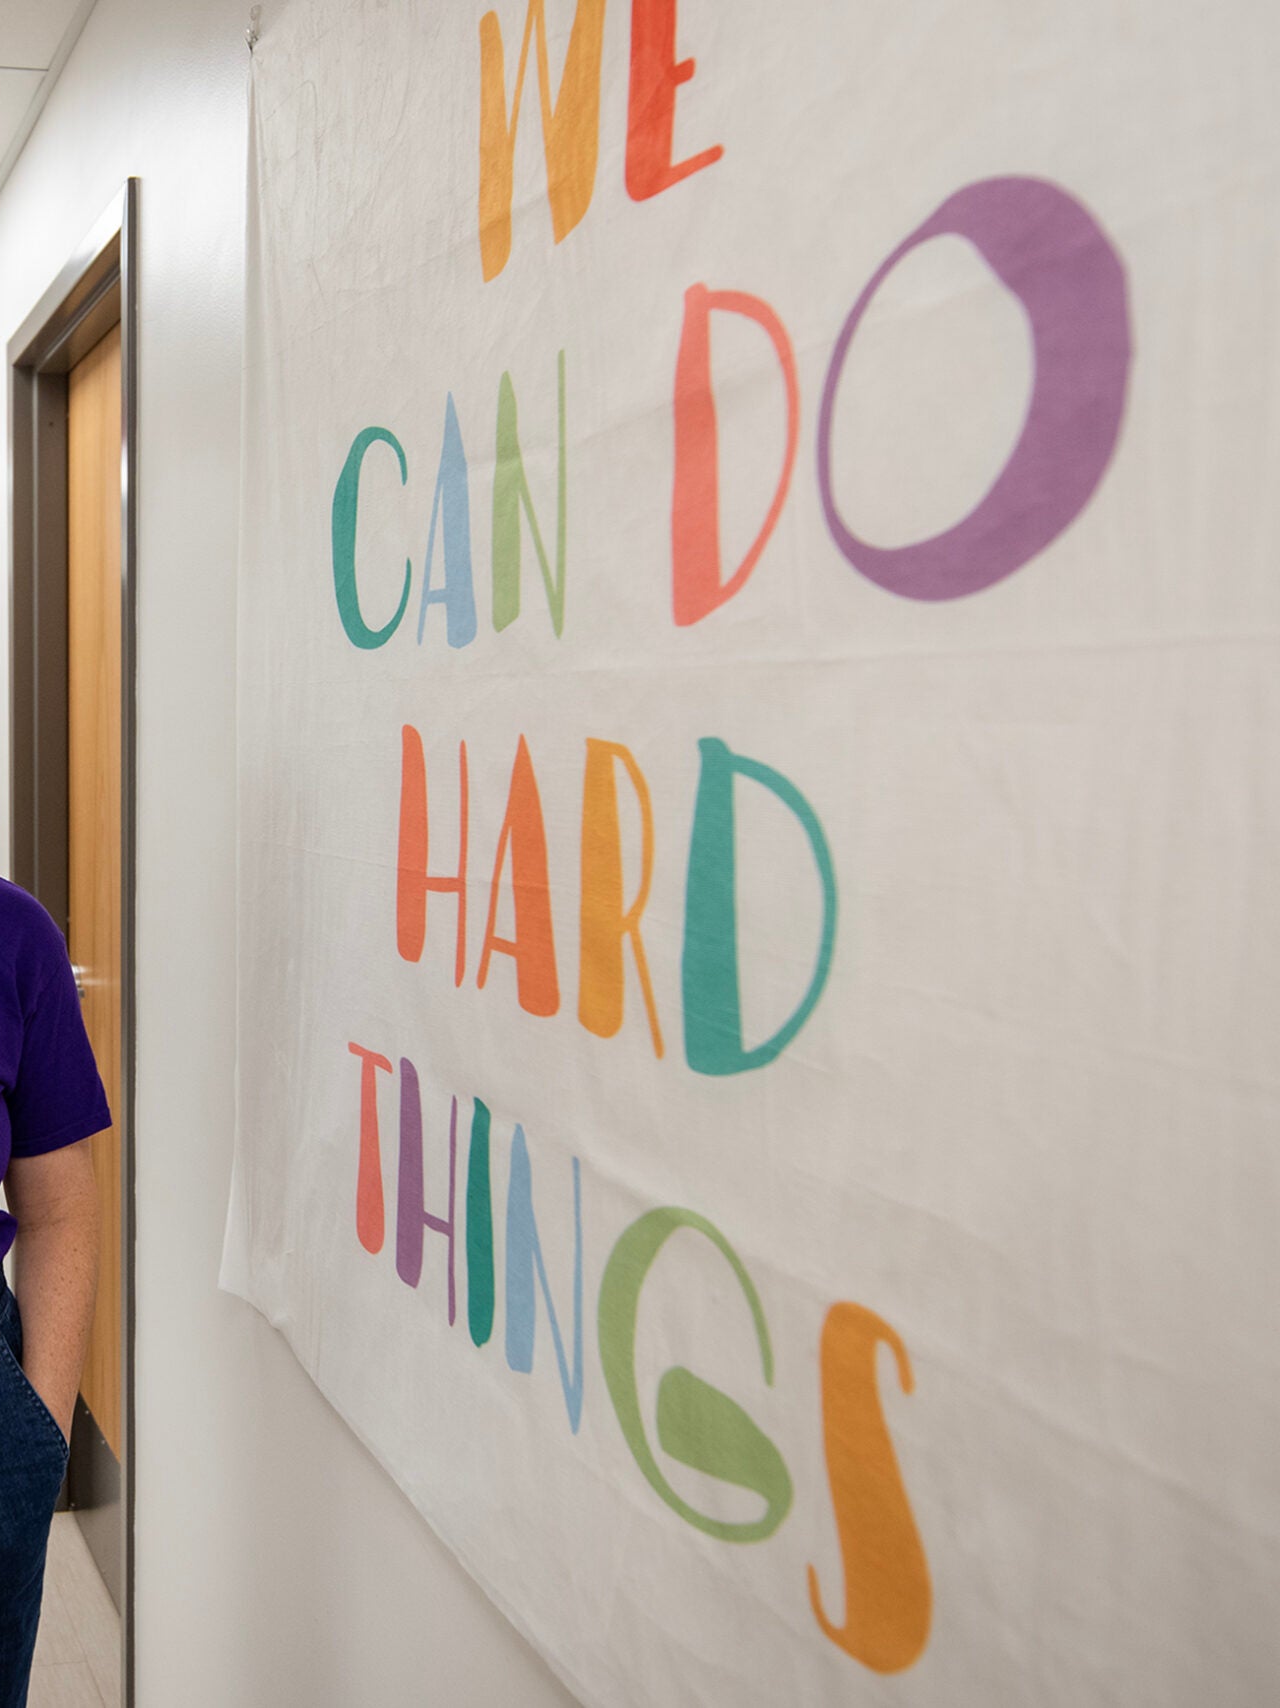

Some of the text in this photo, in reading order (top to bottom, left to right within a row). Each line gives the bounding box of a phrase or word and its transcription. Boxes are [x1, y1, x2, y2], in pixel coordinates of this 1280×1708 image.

[477, 0, 725, 283] WE
[331, 174, 1133, 650] CAN DO
[395, 724, 838, 1077] HARD
[348, 1041, 934, 1676] THINGS
